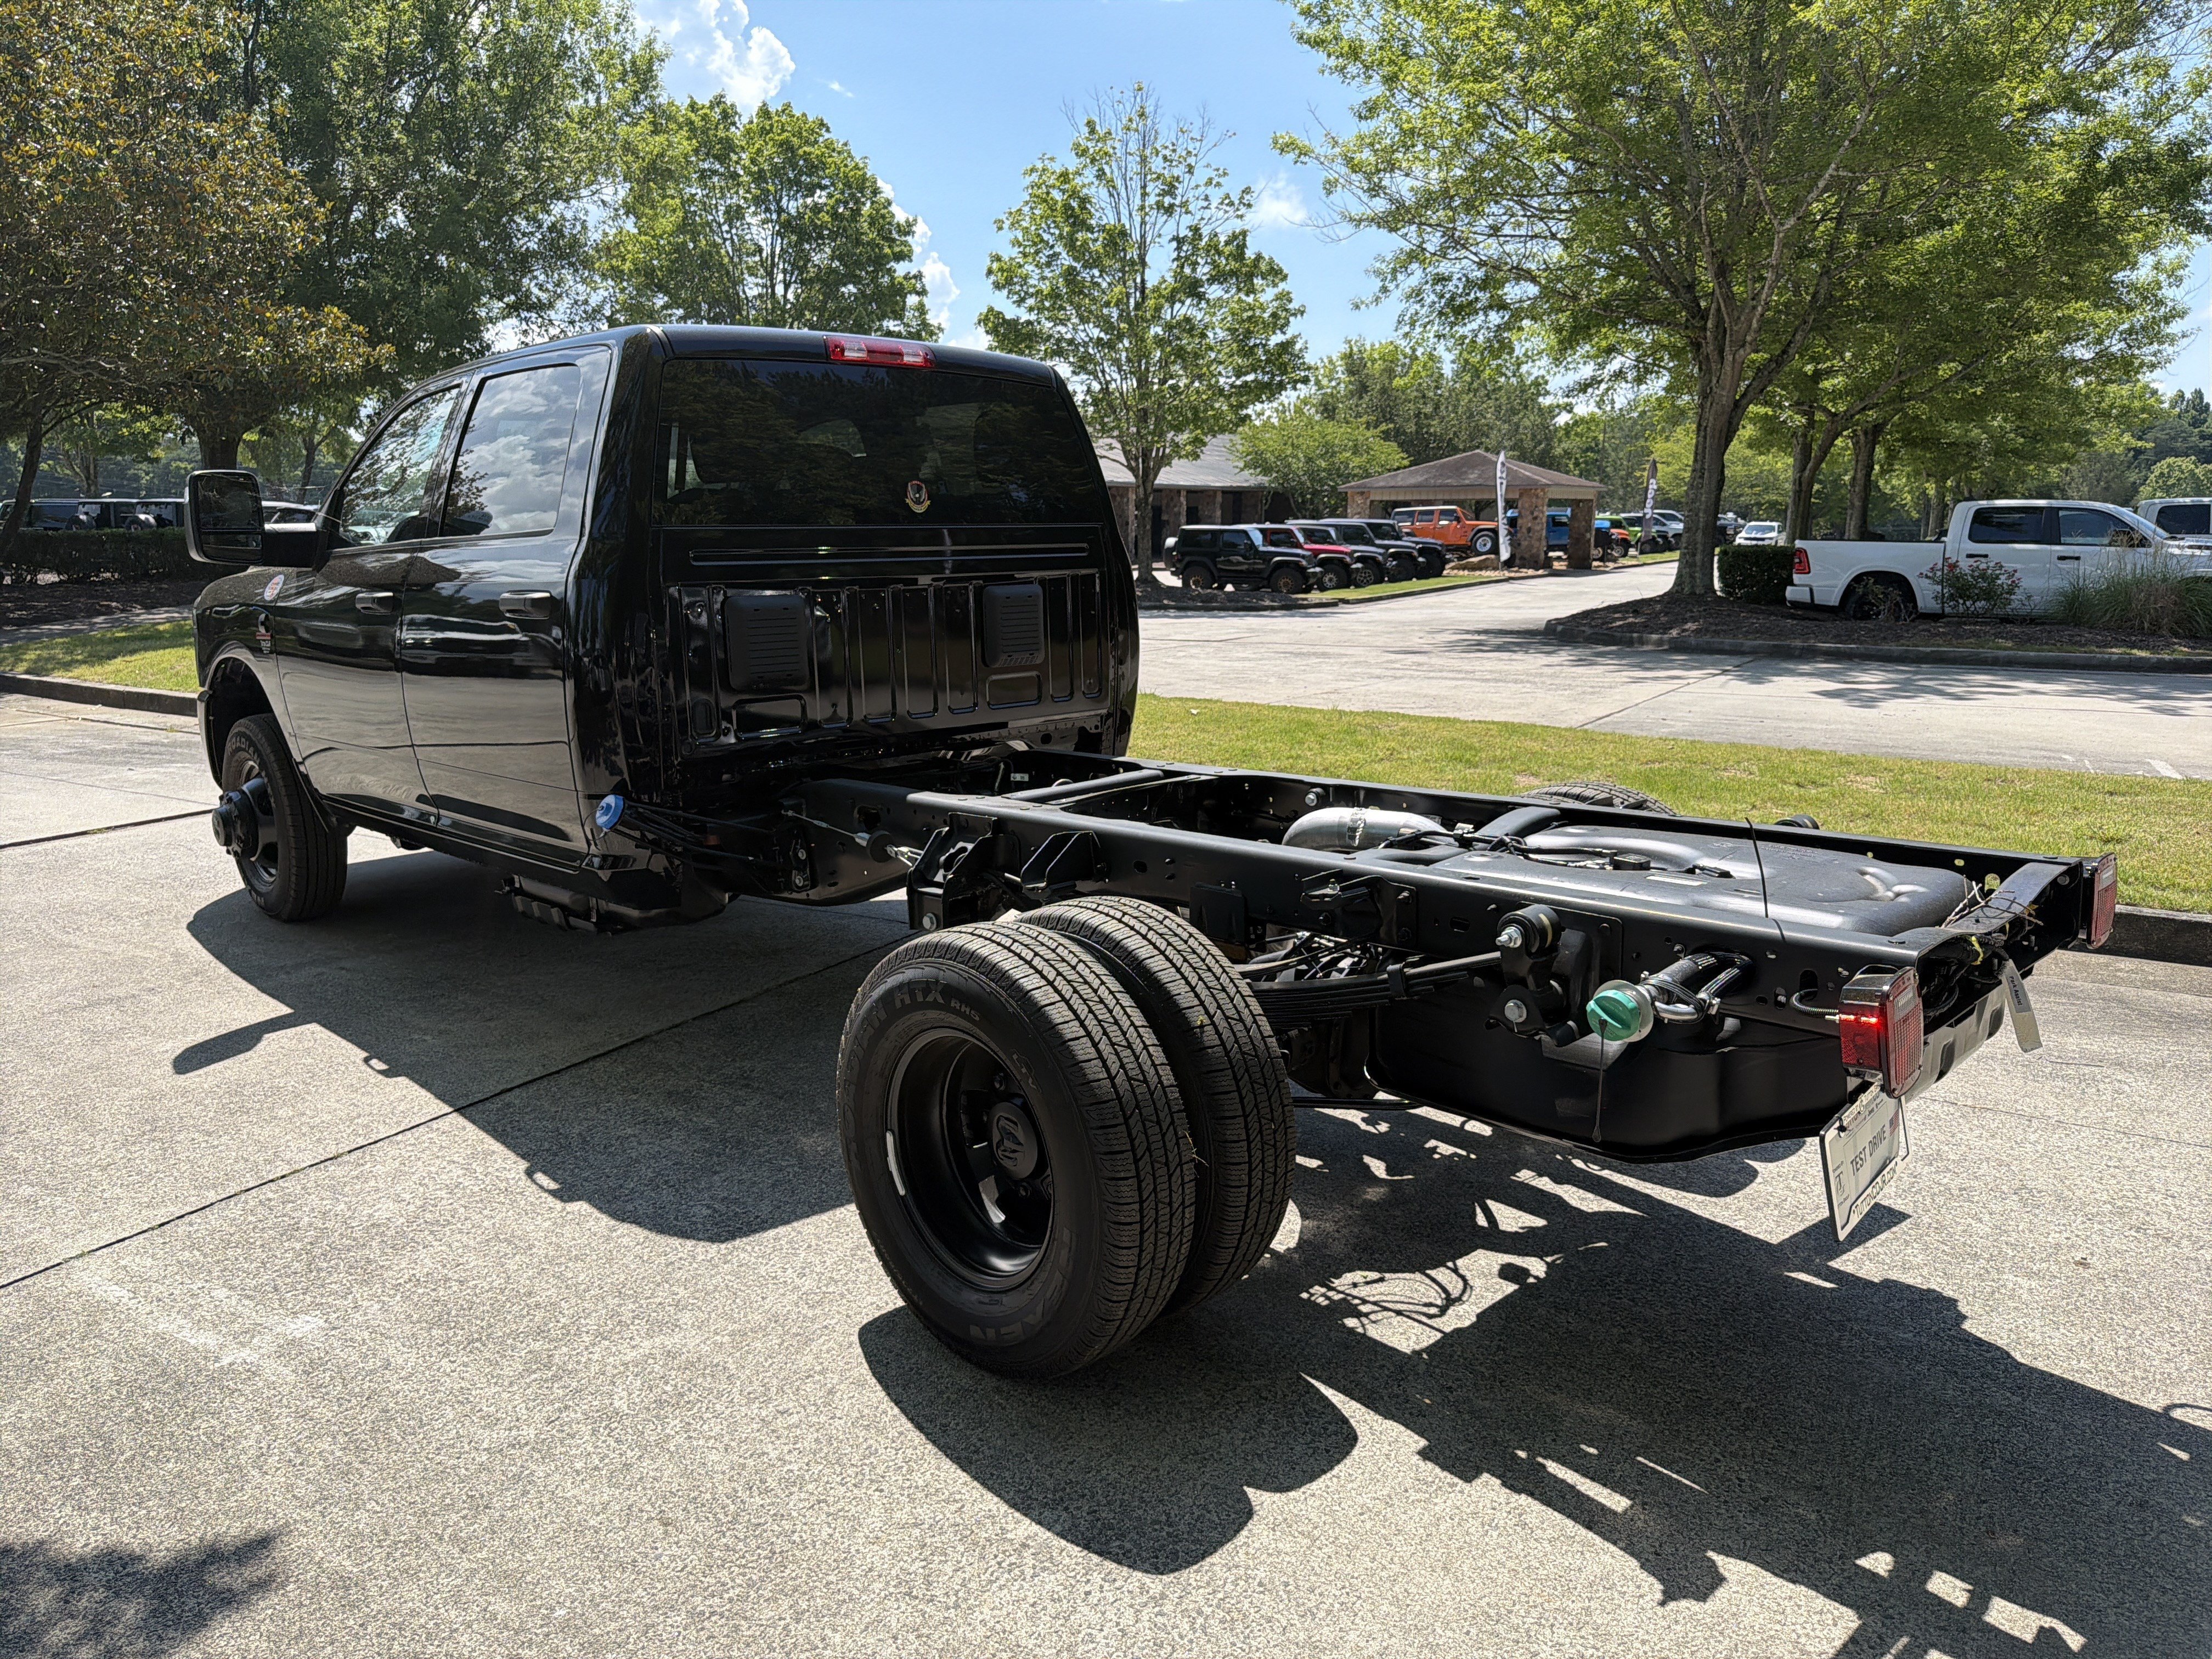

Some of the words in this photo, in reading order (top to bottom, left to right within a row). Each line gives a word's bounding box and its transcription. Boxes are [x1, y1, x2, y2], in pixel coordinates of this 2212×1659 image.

[1644, 478, 1657, 519] Jeep
[894, 980, 947, 1009] HTX
[2009, 976, 2017, 988] Park
[2013, 989, 2023, 1006] Assist
[1850, 1146, 1866, 1176] TEST
[1868, 1124, 1887, 1158] DRIVE
